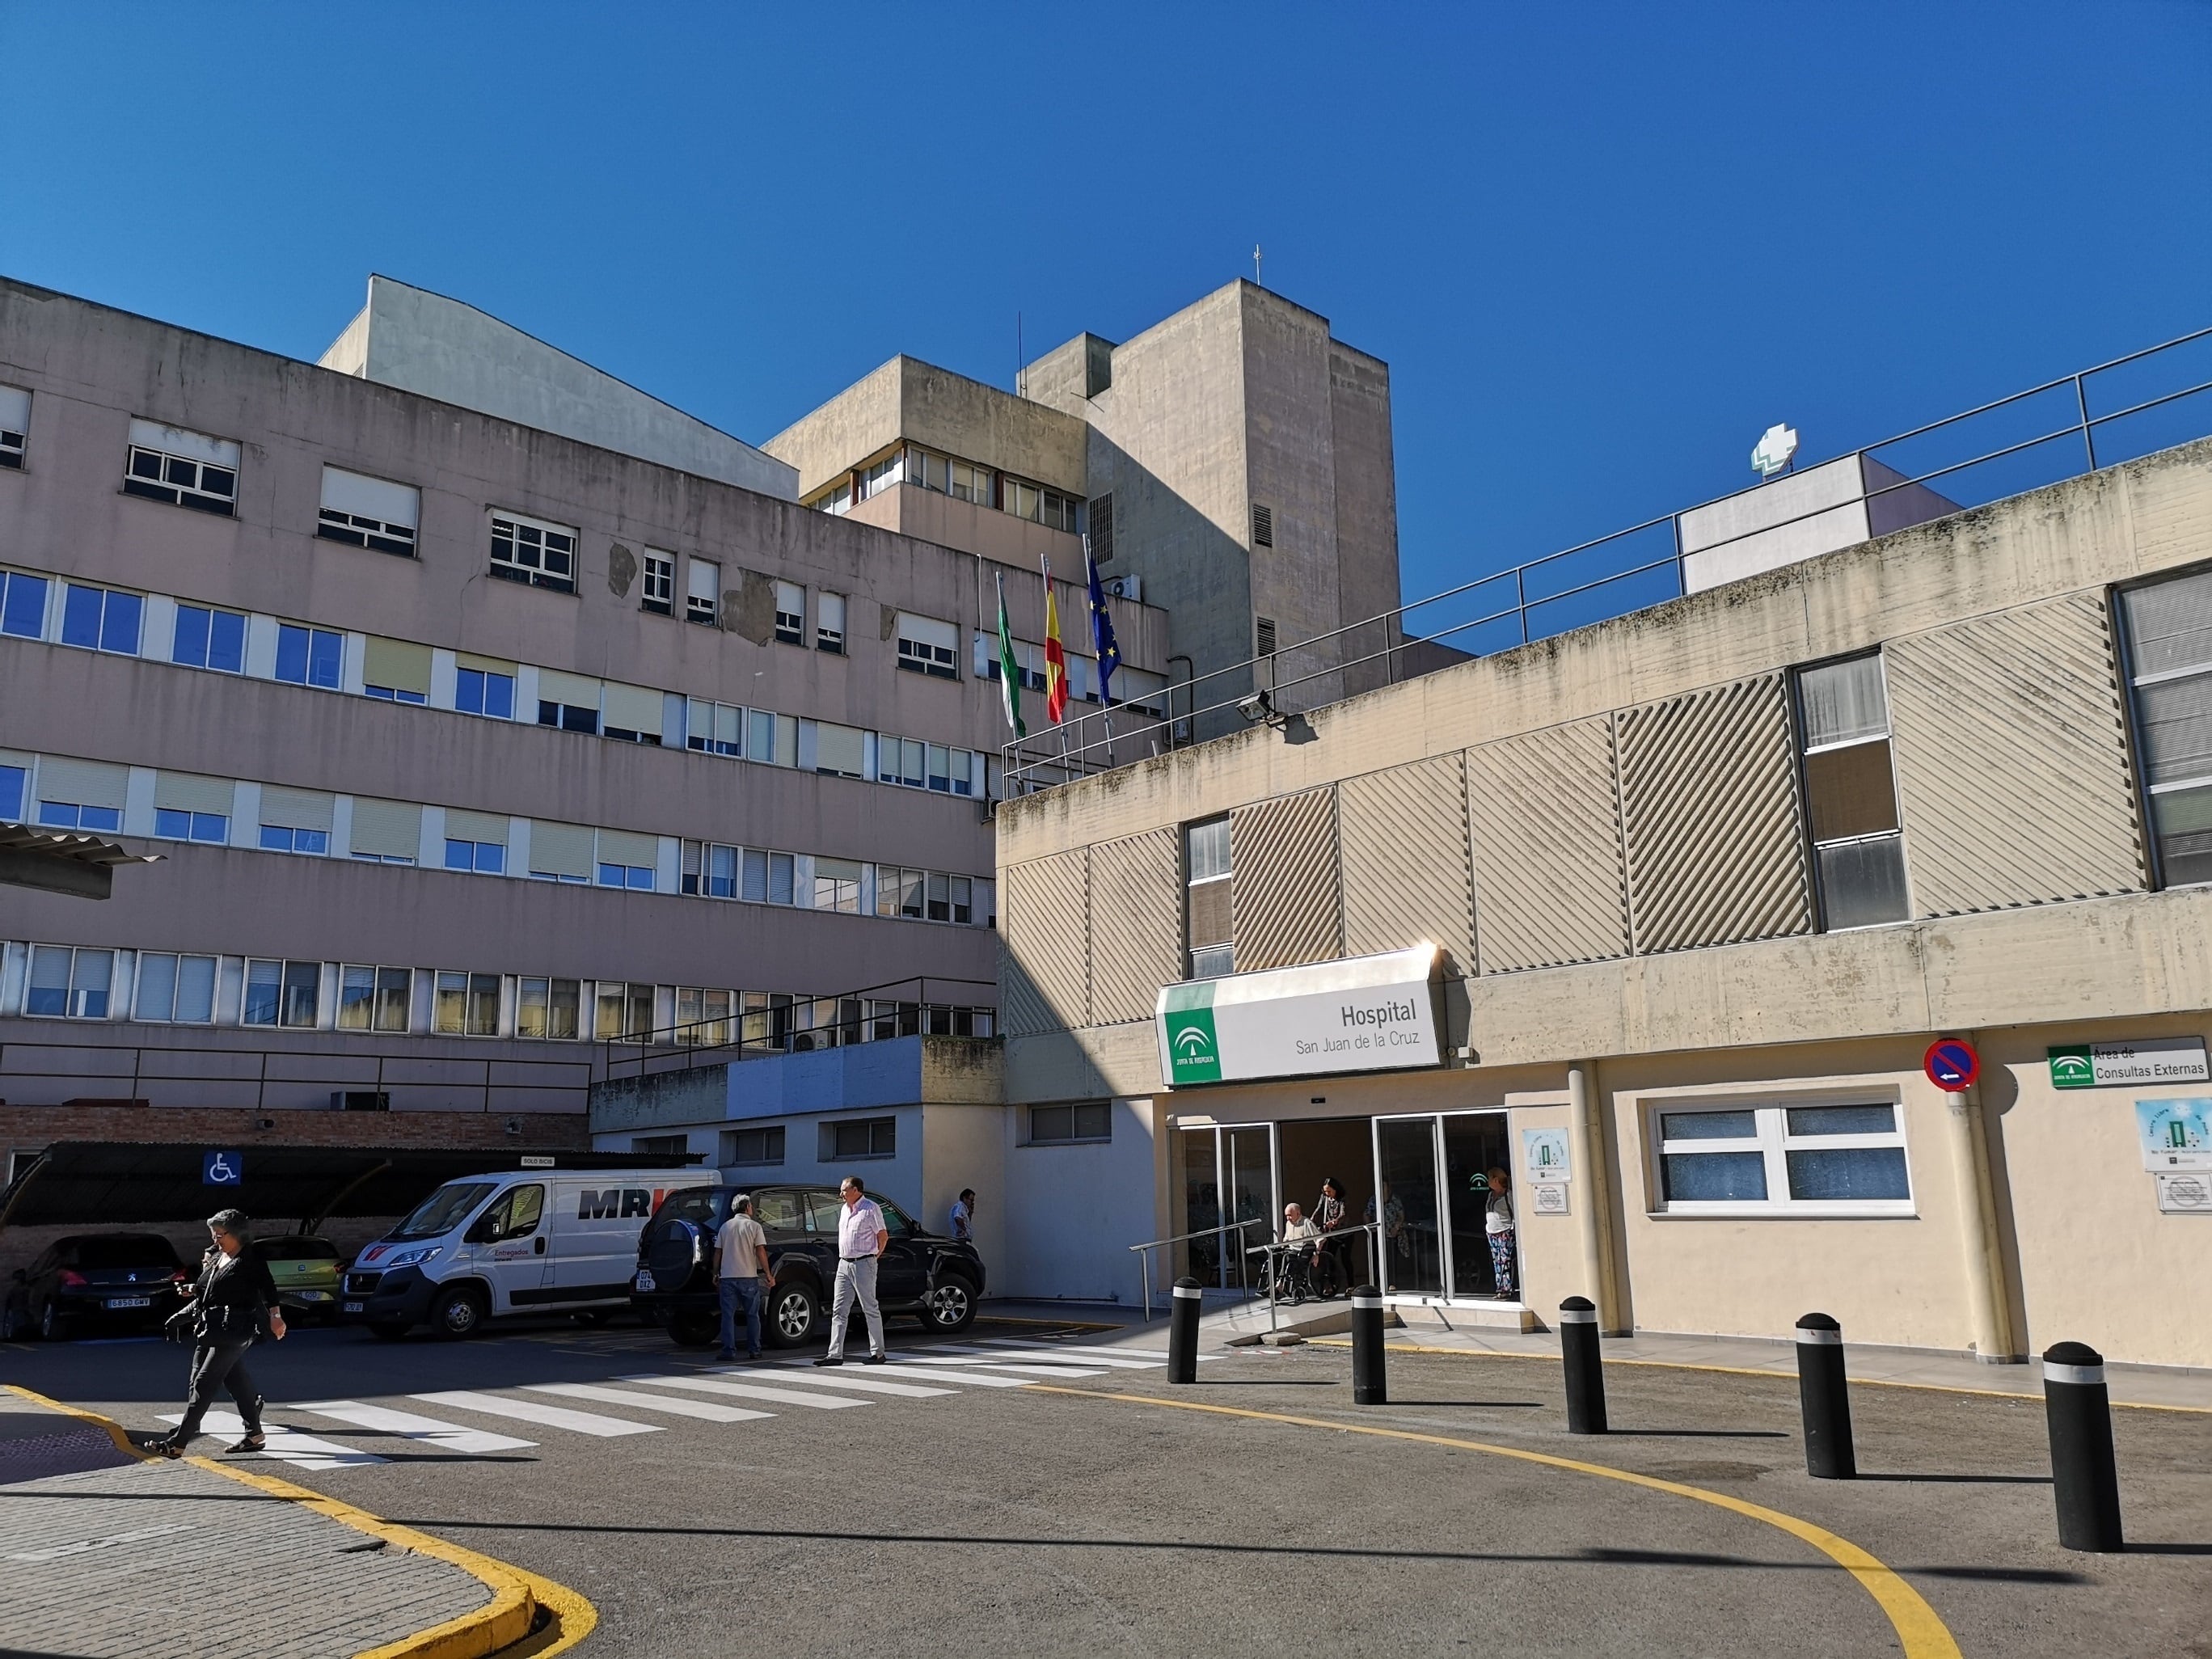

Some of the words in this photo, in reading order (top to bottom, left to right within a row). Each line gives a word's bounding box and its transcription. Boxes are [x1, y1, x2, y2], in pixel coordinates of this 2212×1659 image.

[1341, 998, 1416, 1028] Hospital
[1296, 1040, 1319, 1054] San
[1323, 1037, 1350, 1053] Juan
[1354, 1034, 1370, 1049] de
[1374, 1032, 1385, 1047] la
[1390, 1030, 1420, 1046] Cruz
[2094, 1046, 2119, 1060] Área
[2121, 1047, 2135, 1058] de
[2096, 1066, 2151, 1079] Consultas
[2154, 1064, 2205, 1076] Externas
[578, 1188, 680, 1219] MR
